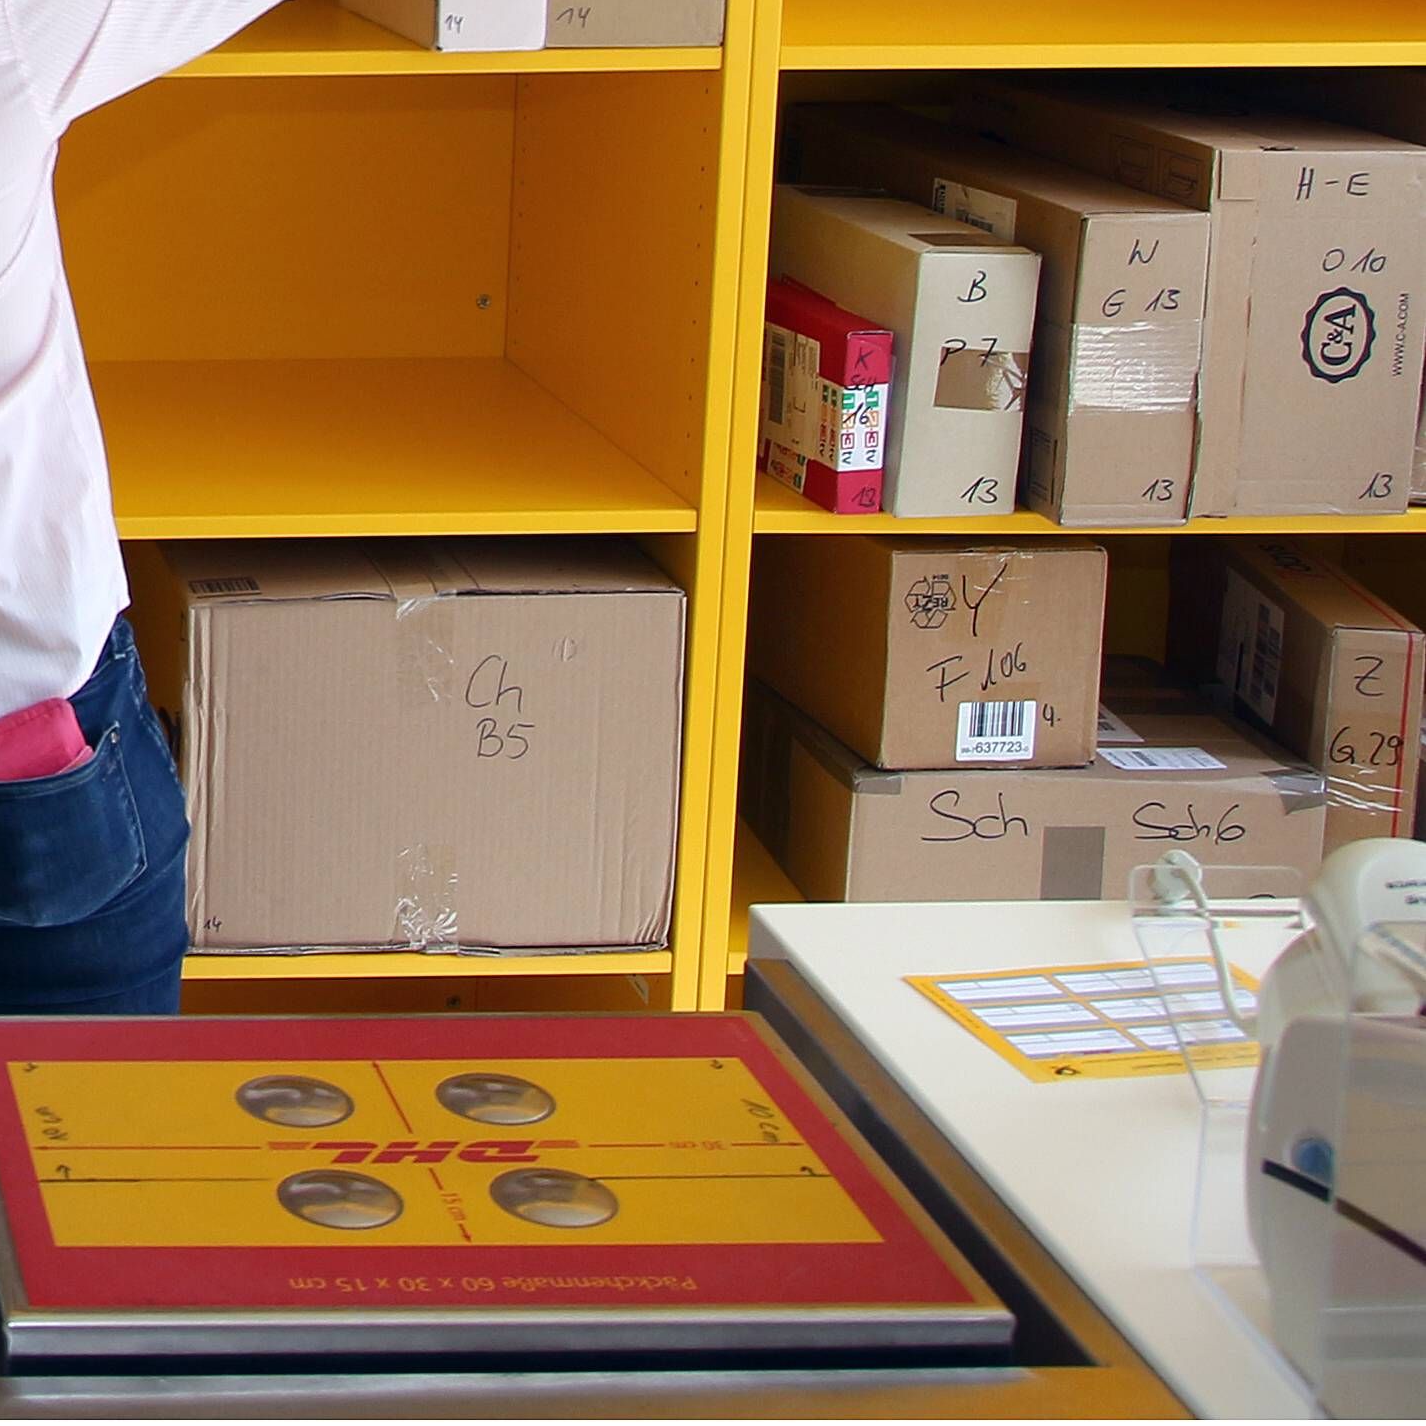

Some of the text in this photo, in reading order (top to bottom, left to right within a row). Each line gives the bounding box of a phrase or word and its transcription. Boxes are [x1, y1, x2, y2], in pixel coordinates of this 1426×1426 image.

[444, 14, 465, 33] 14
[556, 7, 592, 26] 14
[956, 270, 988, 303] B
[1101, 288, 1182, 317] G 13
[1320, 304, 1356, 366] C&A
[1392, 294, 1409, 376] WWW.C-A.COM
[854, 347, 875, 370] K
[842, 401, 871, 425] 16
[960, 477, 999, 504] 13
[1141, 478, 1174, 503] 13
[1358, 473, 1394, 500] 13
[962, 562, 1009, 637] Y
[465, 655, 523, 713] Ch
[1354, 655, 1385, 697] Z
[477, 717, 536, 759] B5
[921, 790, 1029, 842] Sch
[203, 916, 222, 934] 14
[308, 1140, 540, 1165] DHL
[289, 1275, 699, 1293] Päckchenmaße 60 x 30 x 15 cm
